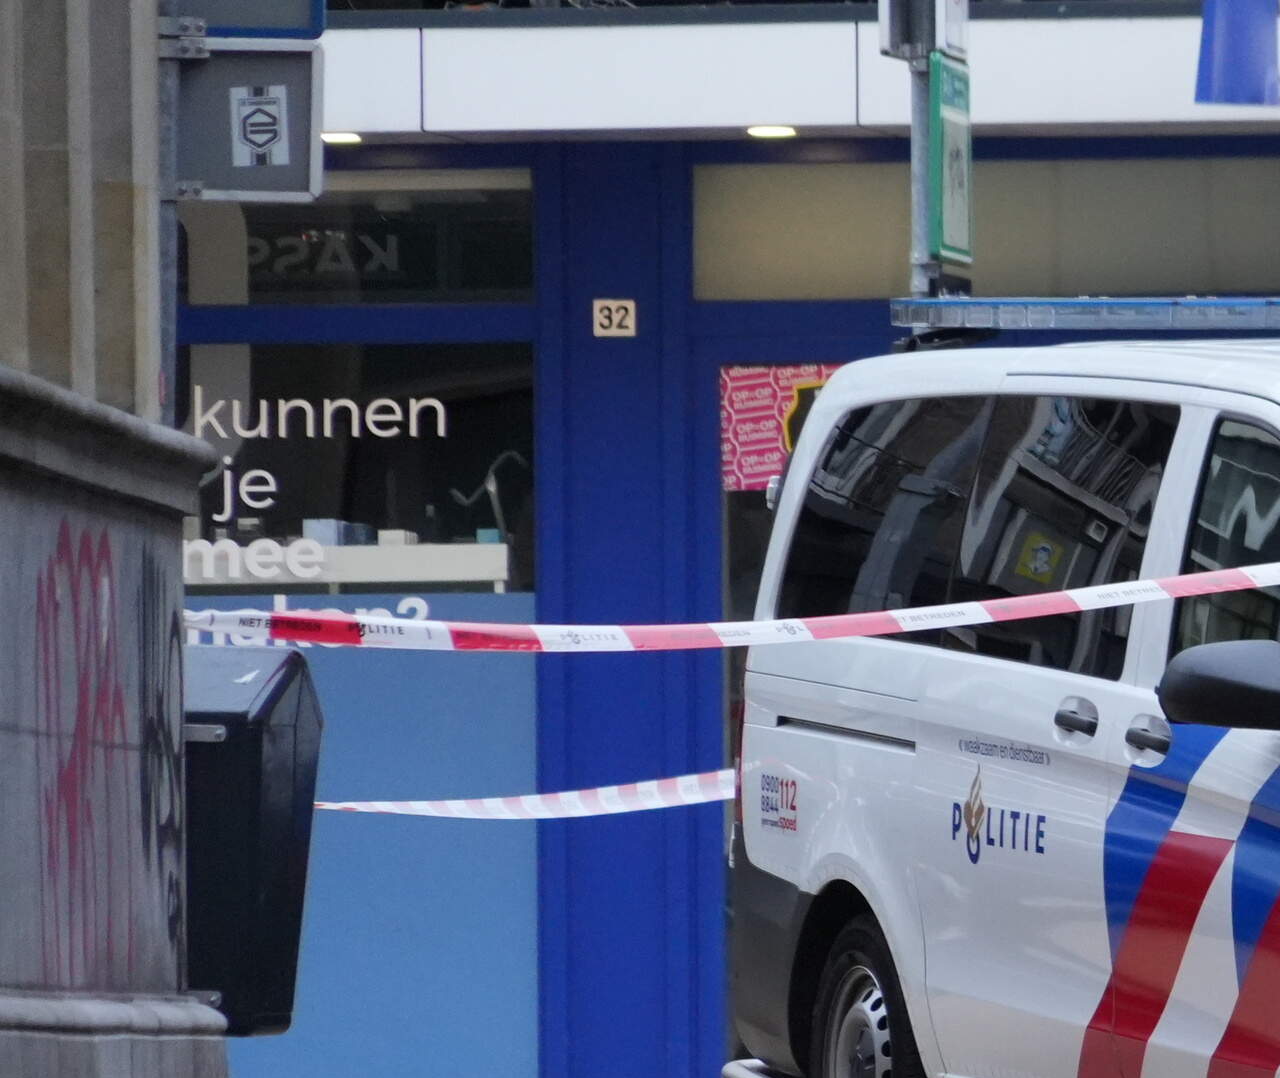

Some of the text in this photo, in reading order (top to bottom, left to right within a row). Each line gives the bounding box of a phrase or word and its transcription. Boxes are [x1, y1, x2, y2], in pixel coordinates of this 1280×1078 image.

[599, 305, 630, 330] 32
[194, 384, 447, 439] kunnen
[211, 455, 277, 523] je
[183, 538, 324, 578] mee
[239, 617, 263, 628] NIET
[761, 774, 797, 811] 0900 112
[952, 802, 1046, 864] POLITIE
